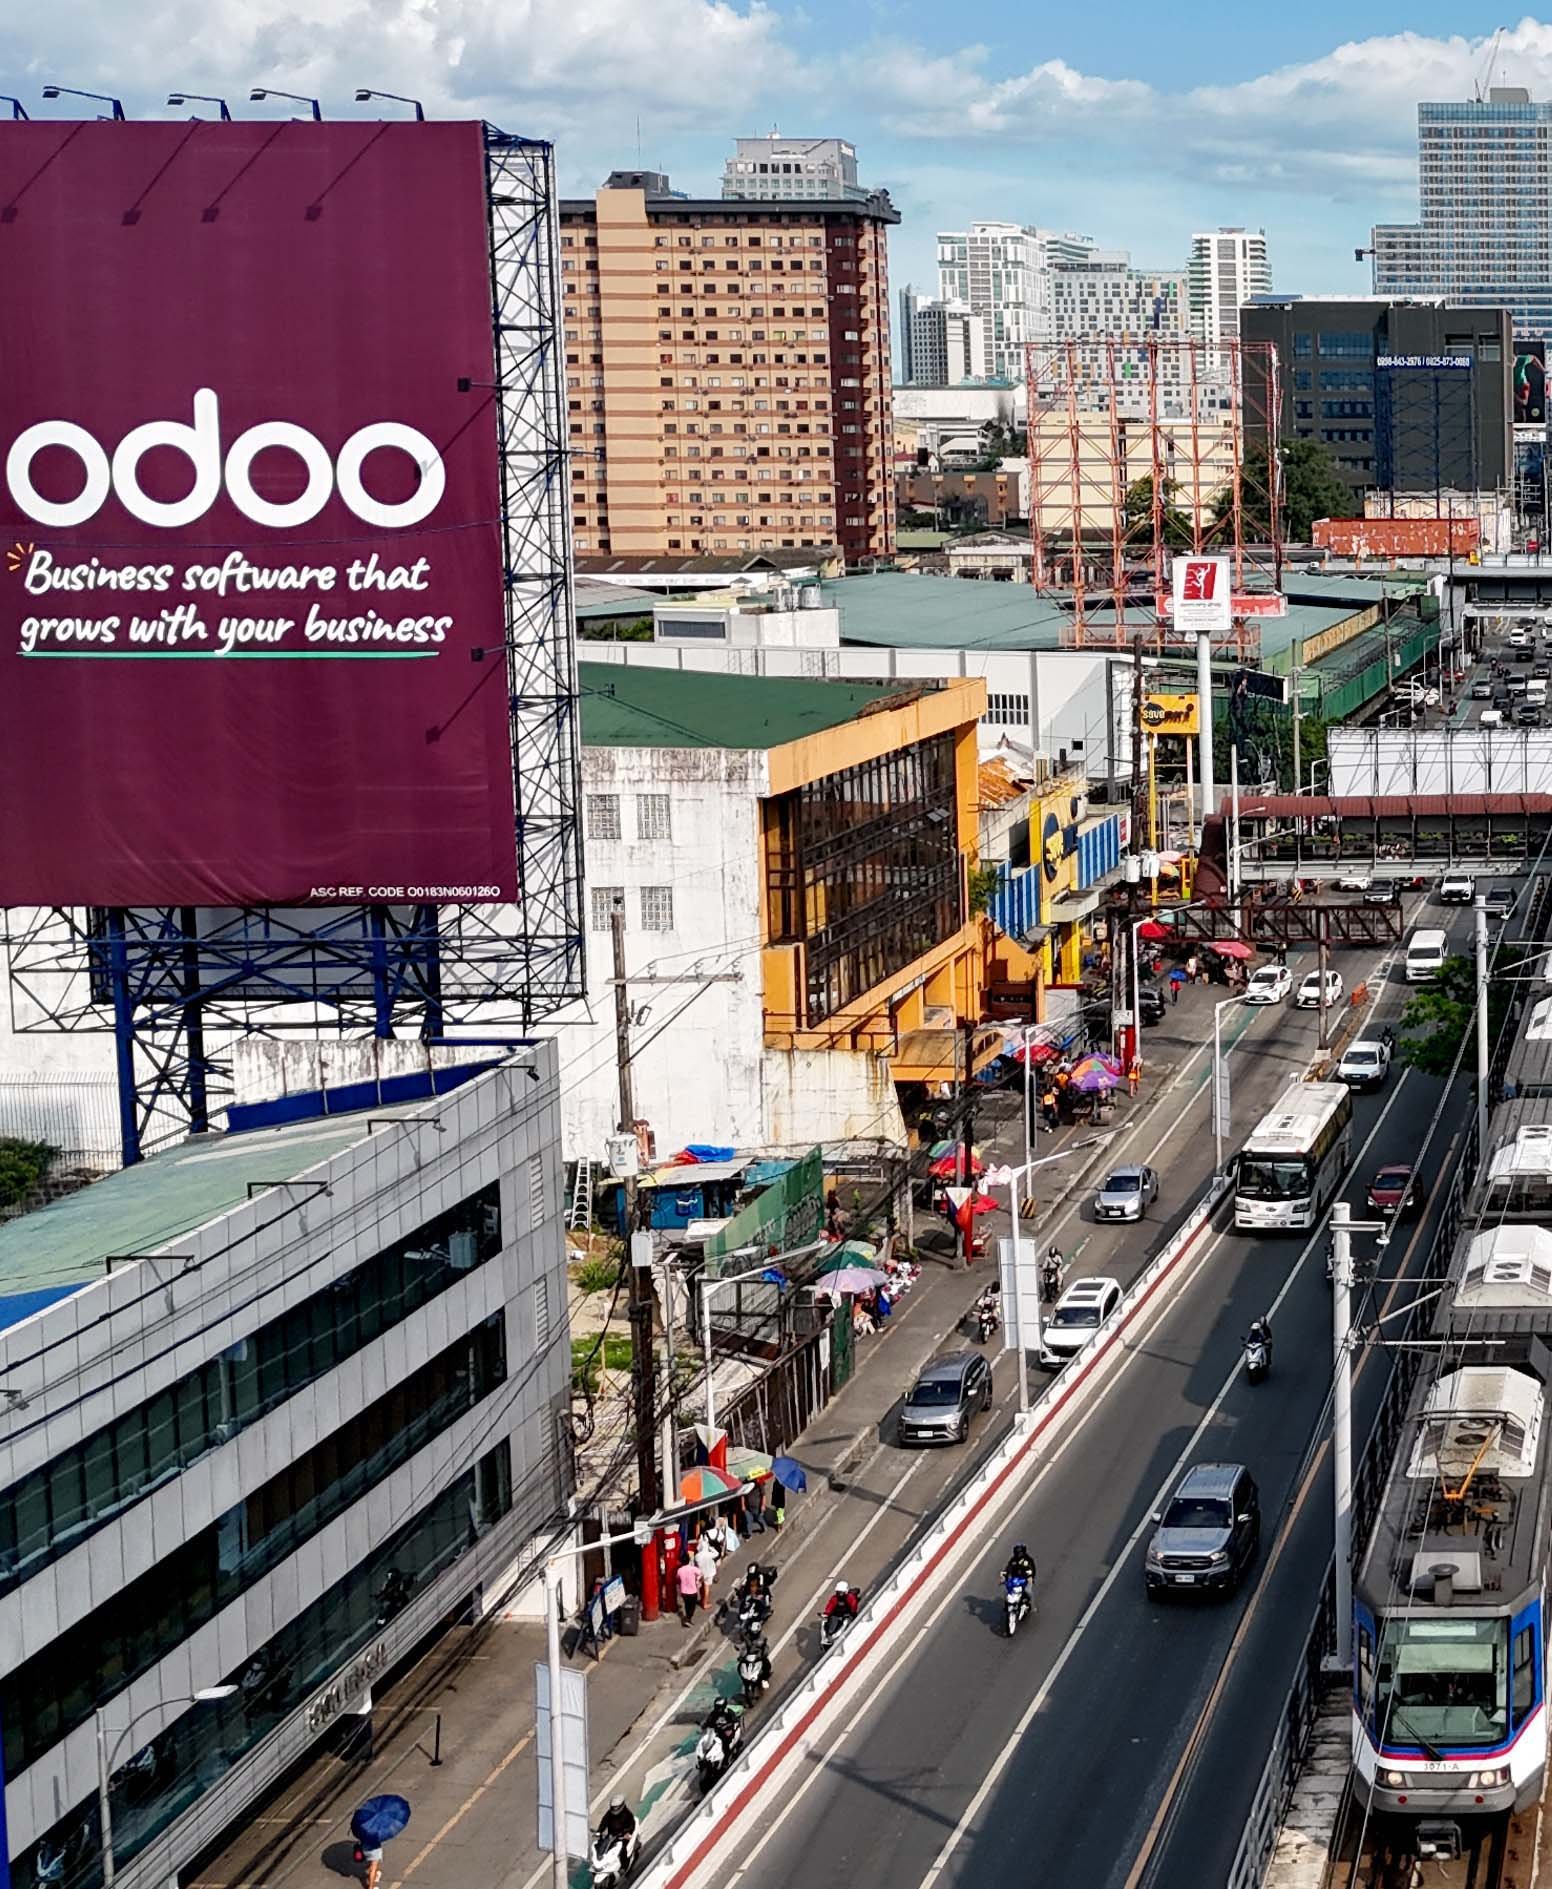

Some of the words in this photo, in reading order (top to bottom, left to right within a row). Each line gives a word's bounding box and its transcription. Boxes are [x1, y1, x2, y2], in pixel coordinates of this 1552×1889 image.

[6, 388, 446, 528] odoo
[25, 550, 174, 595] Business
[182, 550, 337, 597] software
[346, 552, 431, 591] that
[20, 615, 121, 653] grows
[128, 603, 209, 646] with
[214, 616, 295, 654] your
[304, 603, 454, 643] business
[310, 887, 337, 897] ASC
[368, 887, 405, 897] CODE
